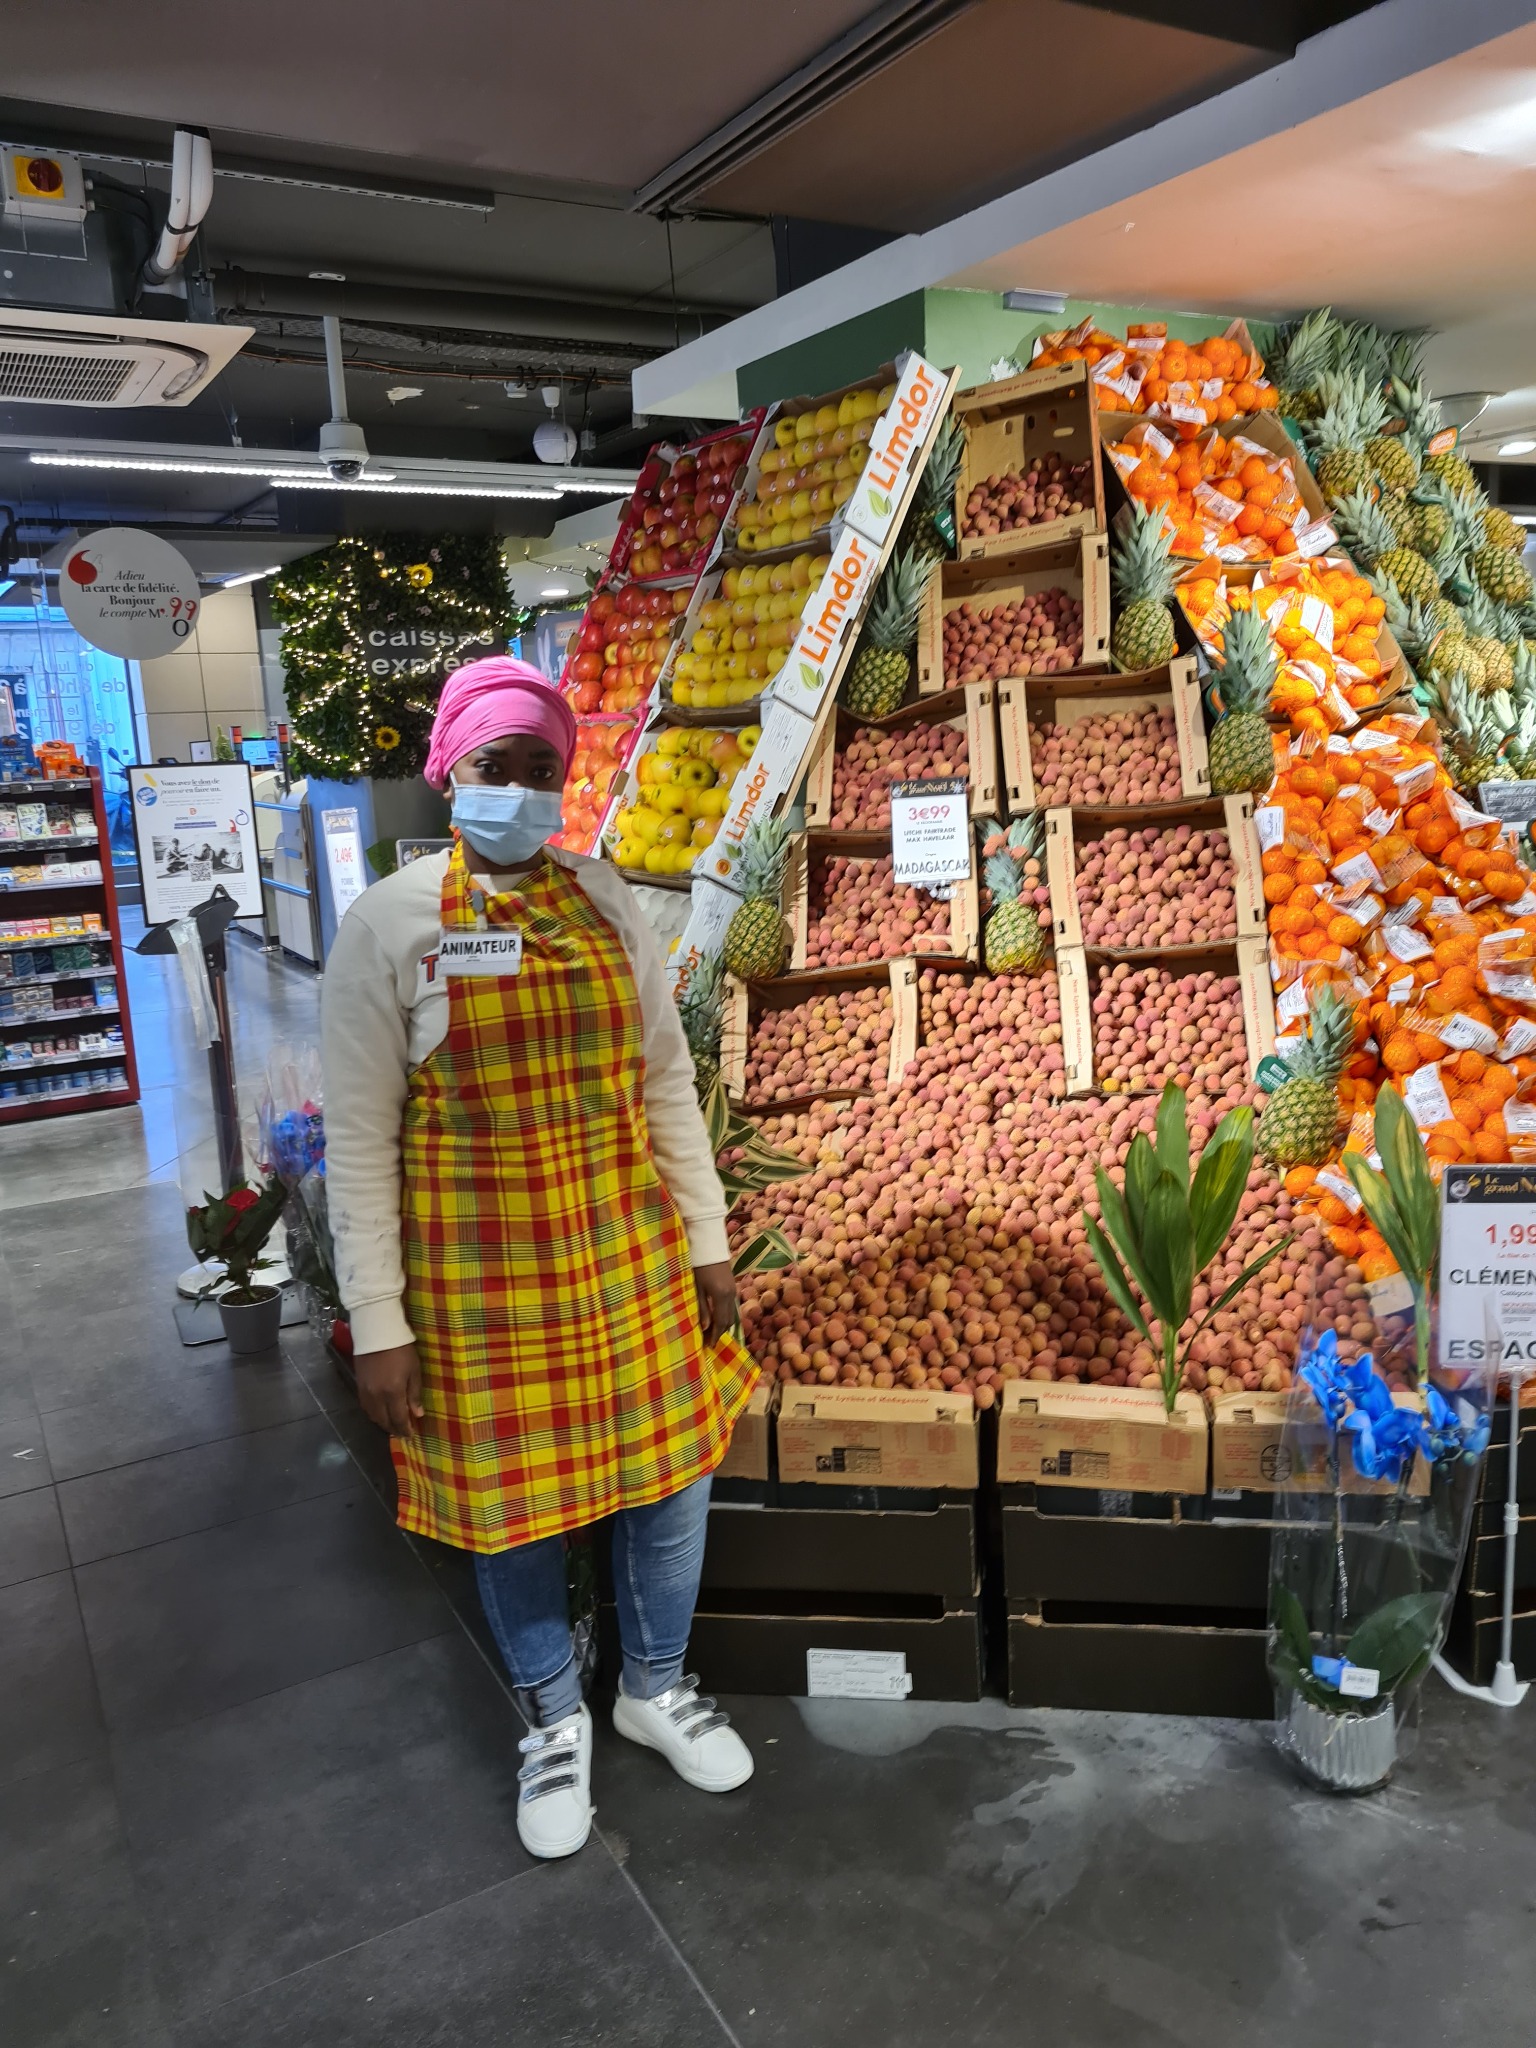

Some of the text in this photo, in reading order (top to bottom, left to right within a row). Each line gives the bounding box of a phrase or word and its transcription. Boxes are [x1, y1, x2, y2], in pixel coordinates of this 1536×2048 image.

[867, 363, 935, 493] Limdor
[115, 570, 145, 581] Adieu
[81, 583, 91, 593] la
[93, 584, 120, 593] carte
[123, 583, 136, 593] de
[109, 595, 156, 608] Bonjour
[799, 537, 869, 665] Limdor
[99, 608, 109, 618] le
[110, 611, 147, 620] compte
[368, 627, 495, 647] caisses
[725, 762, 770, 842] Limdor
[908, 804, 951, 821] 3€99
[923, 834, 955, 842] HAVELAAR
[441, 939, 517, 957] ANIMATEUR
[1484, 1182, 1519, 1196] grand
